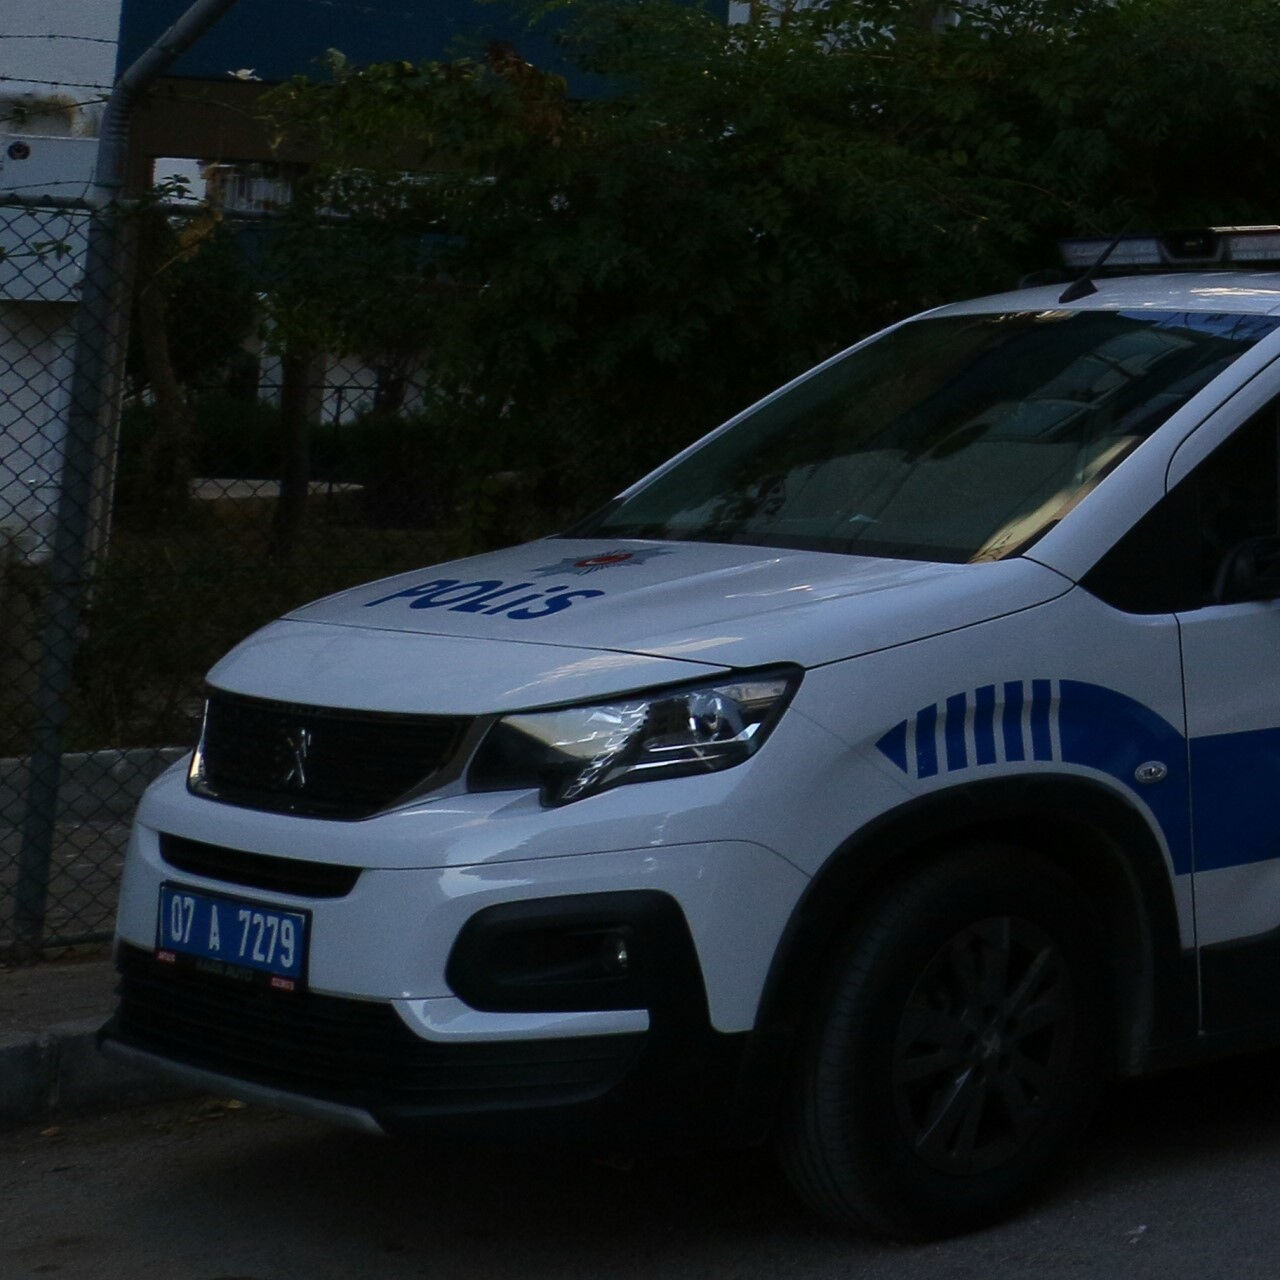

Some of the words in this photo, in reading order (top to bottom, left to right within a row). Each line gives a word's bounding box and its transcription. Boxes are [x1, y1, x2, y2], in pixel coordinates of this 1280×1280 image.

[171, 894, 195, 944] 07
[208, 904, 220, 951] A
[238, 909, 295, 968] 7279
